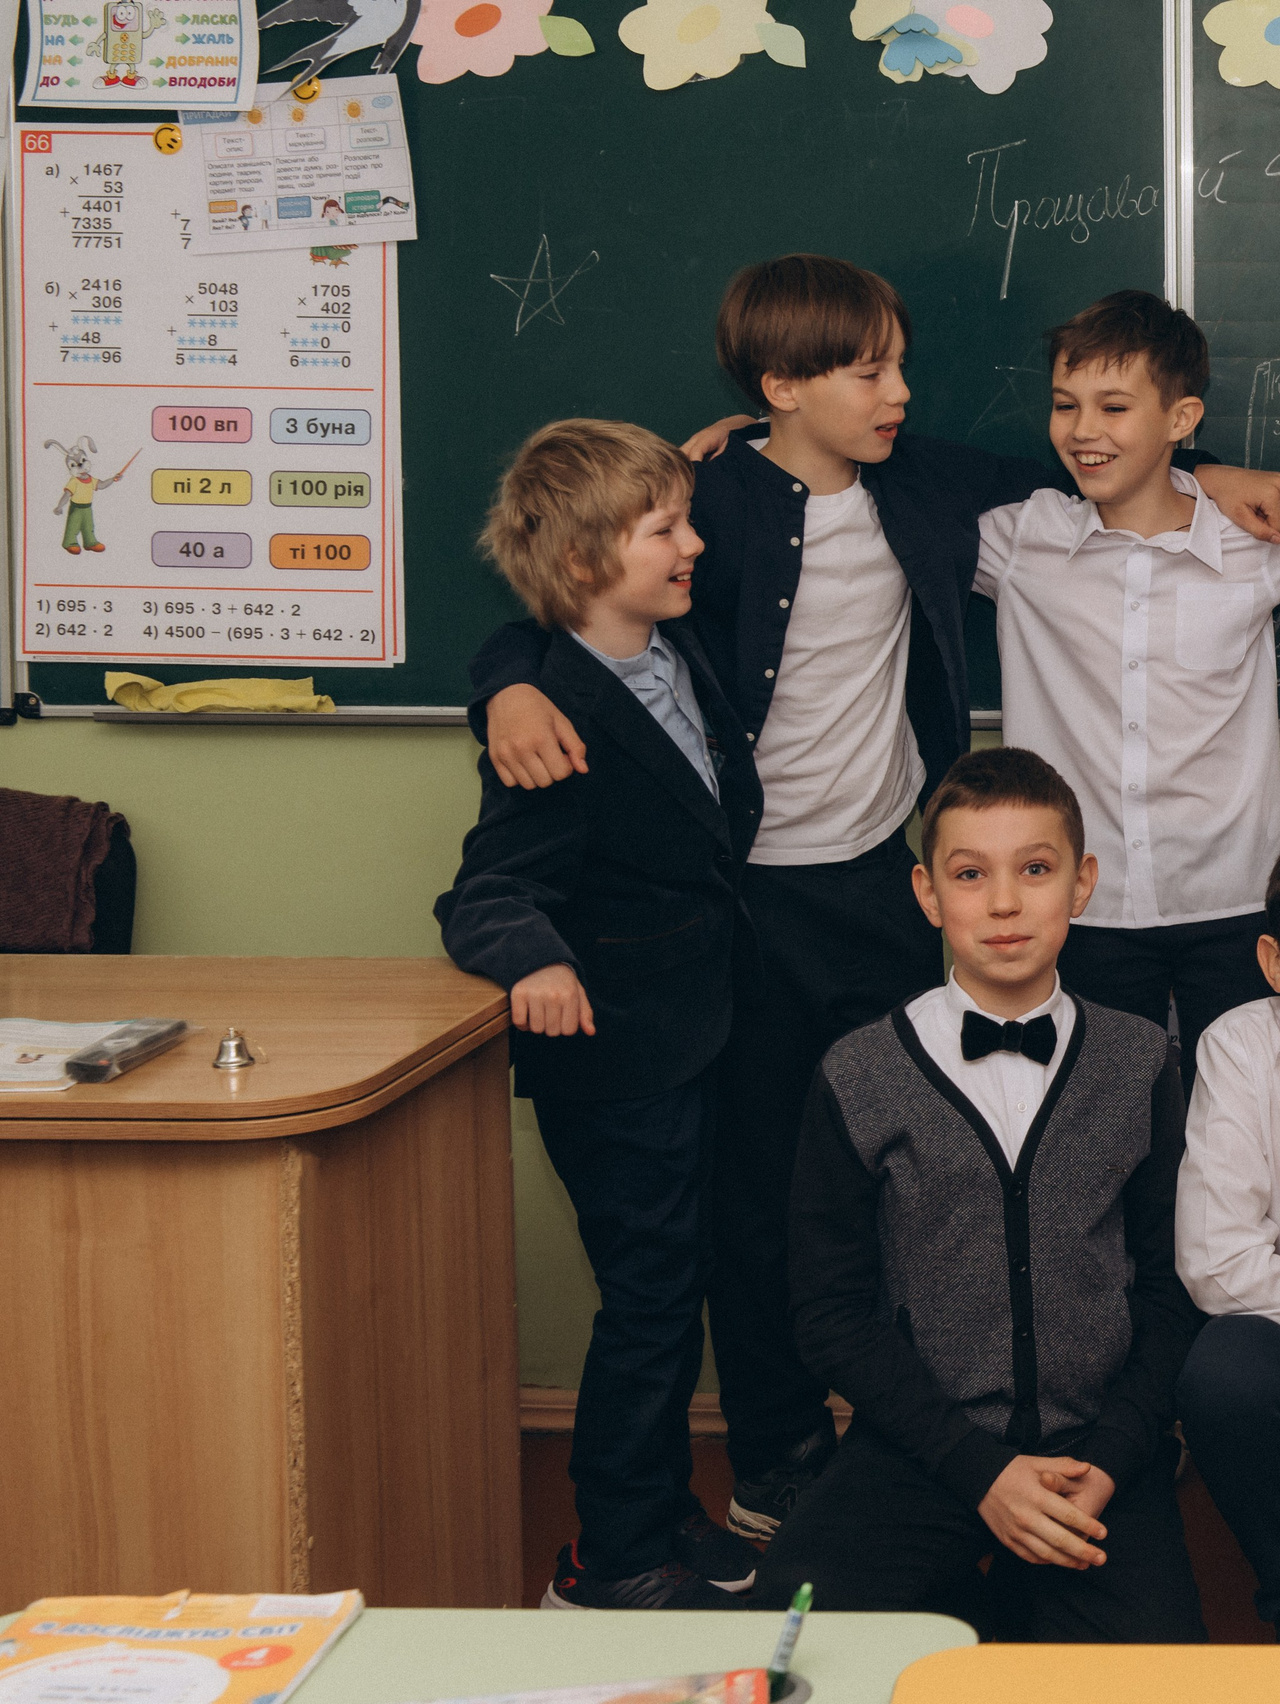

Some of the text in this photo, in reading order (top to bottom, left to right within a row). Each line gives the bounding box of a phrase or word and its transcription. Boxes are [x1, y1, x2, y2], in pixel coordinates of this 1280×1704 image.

[43, 13, 238, 27] БУДЬ ЛАСКА
[44, 33, 235, 46] НА ЖАЛЬ
[42, 55, 238, 69] НА ДОБРАНІЧ
[39, 76, 237, 89] ДО ВПОДОБИ
[25, 134, 50, 151] 66
[45, 163, 60, 179] а)
[83, 163, 124, 177] 1467
[103, 181, 124, 194] 53
[81, 200, 123, 213] 4401
[71, 217, 113, 230] 7335
[180, 219, 191, 231] 7
[72, 235, 123, 249] 77751
[181, 237, 191, 250] 7
[45, 280, 60, 297] б)
[81, 278, 122, 292] 2416
[198, 282, 239, 296] 5048
[311, 284, 351, 298] 1705
[91, 296, 122, 309] 306
[209, 300, 239, 313] 103
[320, 301, 351, 315] 402
[168, 415, 238, 432] 100 вп
[285, 417, 356, 439] 3 буна
[173, 478, 232, 495] пі 2 л
[277, 480, 365, 501] і 100 рія
[179, 542, 225, 558] 40 а
[289, 544, 352, 561] ті 100
[36, 599, 51, 615] 1)
[57, 599, 87, 613] 695
[104, 600, 113, 614] 3
[143, 601, 159, 616] 3)
[164, 602, 195, 615] 695
[212, 602, 222, 616] 3
[227, 604, 238, 614] +
[243, 603, 274, 616] 642
[291, 604, 301, 617] 2
[35, 623, 51, 638] 2)
[57, 623, 87, 636] 642
[103, 624, 113, 637] 2
[143, 625, 159, 641] 4)
[165, 626, 206, 639] 4500
[227, 626, 264, 643] (695
[280, 628, 290, 641] 3
[296, 630, 306, 640] +
[312, 629, 343, 642] 642
[360, 629, 376, 645] 2)
